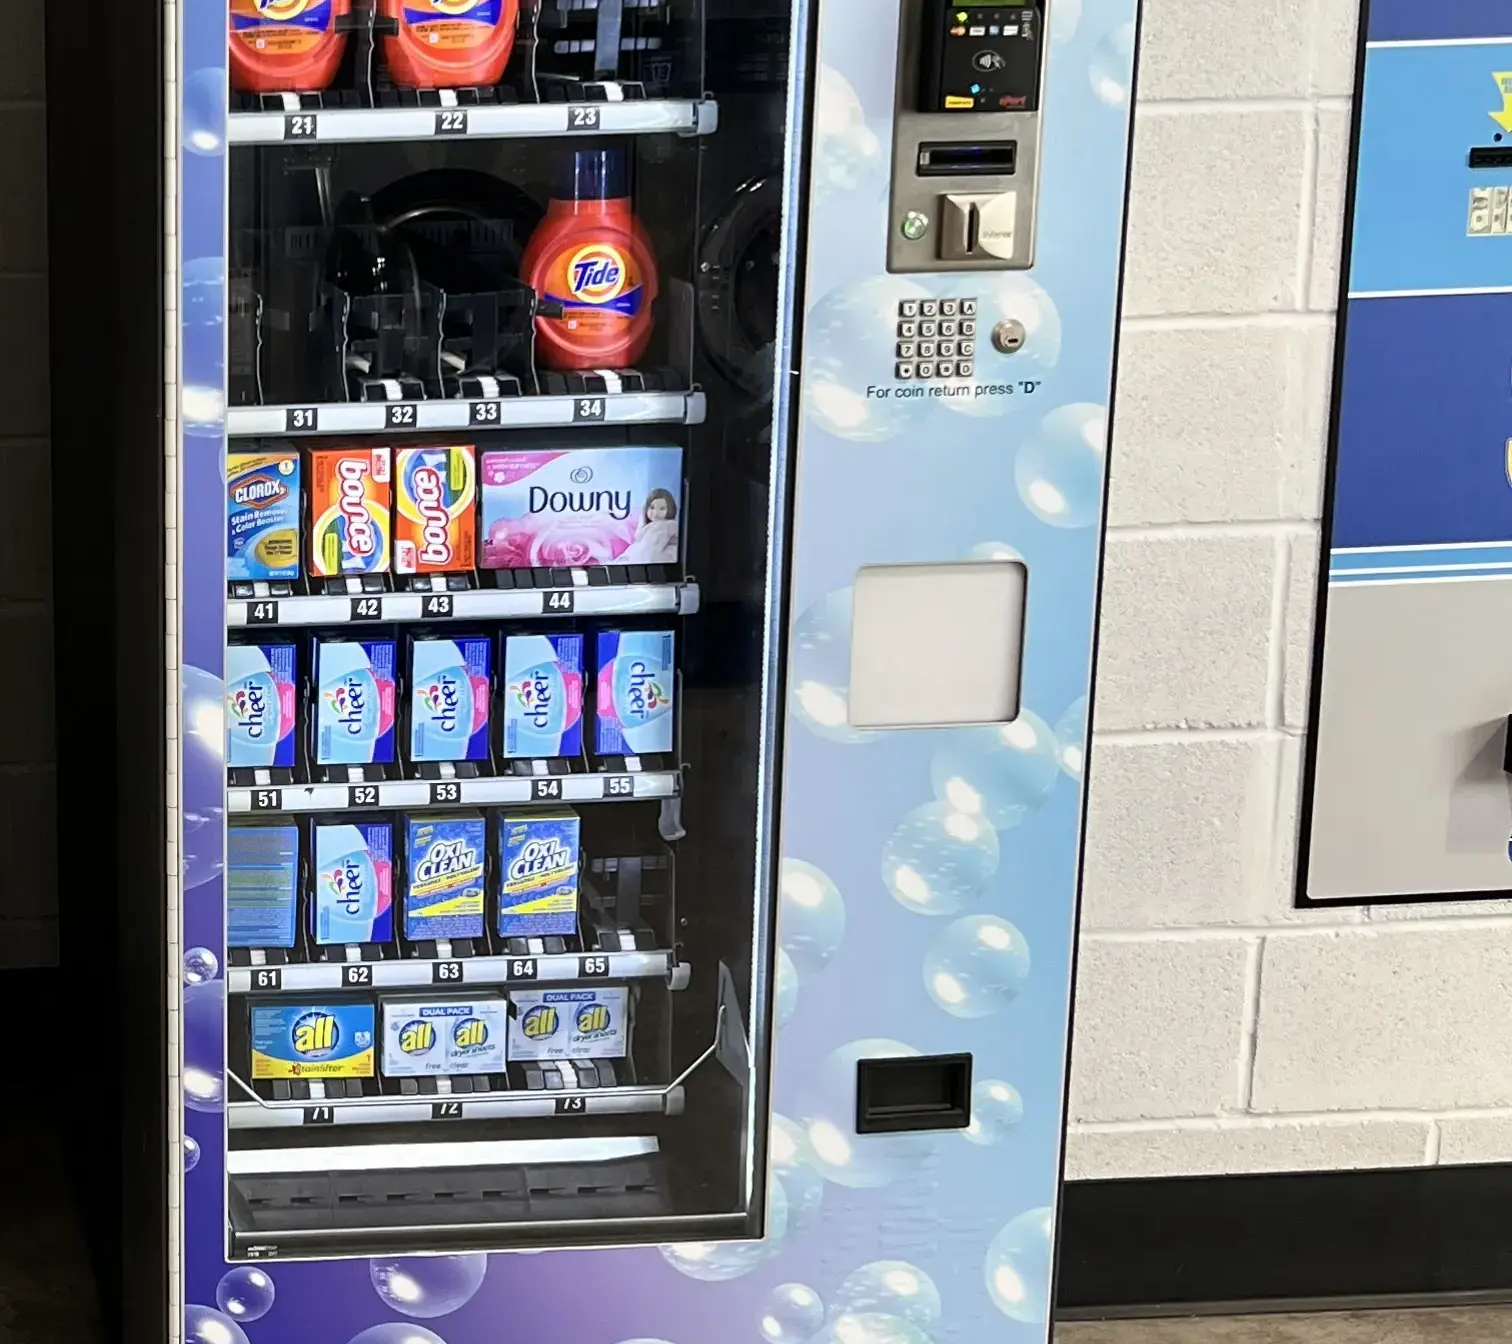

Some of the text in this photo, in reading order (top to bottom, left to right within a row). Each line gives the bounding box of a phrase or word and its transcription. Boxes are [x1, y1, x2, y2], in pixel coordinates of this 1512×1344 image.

[292, 116, 312, 134] 21
[441, 112, 463, 130] 22
[574, 108, 596, 126] 23
[574, 260, 619, 292] Tide
[867, 386, 891, 398] For
[895, 385, 923, 397] coin
[929, 385, 970, 397] return
[975, 385, 1013, 398] press
[392, 406, 412, 423] 32
[476, 404, 496, 420] 33
[581, 400, 601, 416] 34
[294, 410, 312, 426] 31
[235, 479, 280, 503] CLOROX
[339, 459, 374, 554] bounce
[529, 486, 631, 520] Downy
[232, 511, 253, 526] Stain
[415, 468, 451, 564] bounce
[236, 521, 256, 533] Color
[357, 599, 377, 615] 42
[428, 597, 449, 612] 43
[549, 593, 570, 608] 44
[255, 603, 272, 619] 41
[524, 670, 551, 728] cheer
[627, 661, 654, 719] cheer
[238, 680, 265, 738] cheer
[339, 677, 364, 735] cheer
[431, 674, 456, 732] cheer
[437, 785, 456, 800] 53
[538, 781, 558, 796] 54
[610, 778, 630, 793] 55
[259, 791, 276, 806] 51
[355, 788, 375, 803] 52
[430, 841, 463, 862] OXI
[524, 841, 556, 862] OXI
[418, 851, 473, 881] CLEAN
[511, 850, 567, 881] CLEAN
[337, 859, 362, 914] cheer
[349, 967, 368, 982] 62
[439, 964, 459, 978] 63
[514, 961, 533, 975] 64
[585, 958, 605, 973] 65
[259, 971, 276, 985] 61
[524, 1007, 556, 1038] all
[578, 1005, 607, 1032] all
[295, 1015, 334, 1052] all
[401, 1022, 432, 1052] all
[455, 1020, 484, 1047] all
